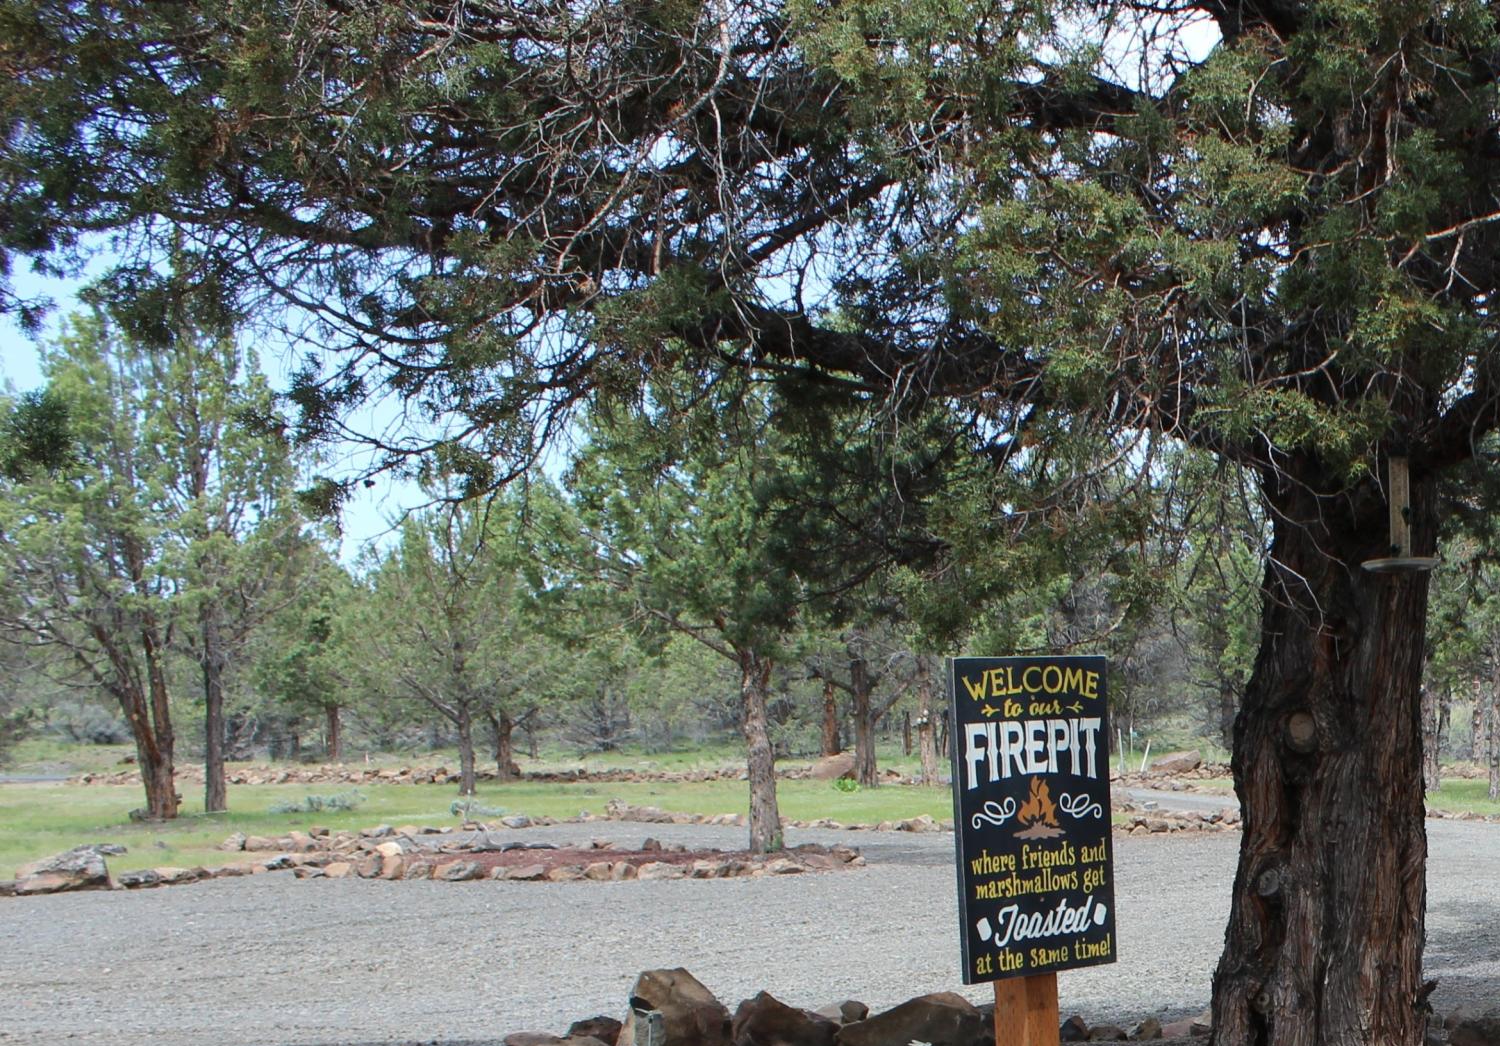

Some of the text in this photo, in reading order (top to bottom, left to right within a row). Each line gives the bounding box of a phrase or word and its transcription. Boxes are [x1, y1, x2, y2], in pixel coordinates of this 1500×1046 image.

[962, 665, 1099, 701] WELCOME
[1003, 698, 1064, 718] to our
[964, 716, 1101, 790] FIREPIT
[971, 837, 1107, 875] where friends and
[975, 865, 1106, 899] marshmallows get
[994, 895, 1094, 947] Toasted
[976, 932, 1111, 975] at the same time!
